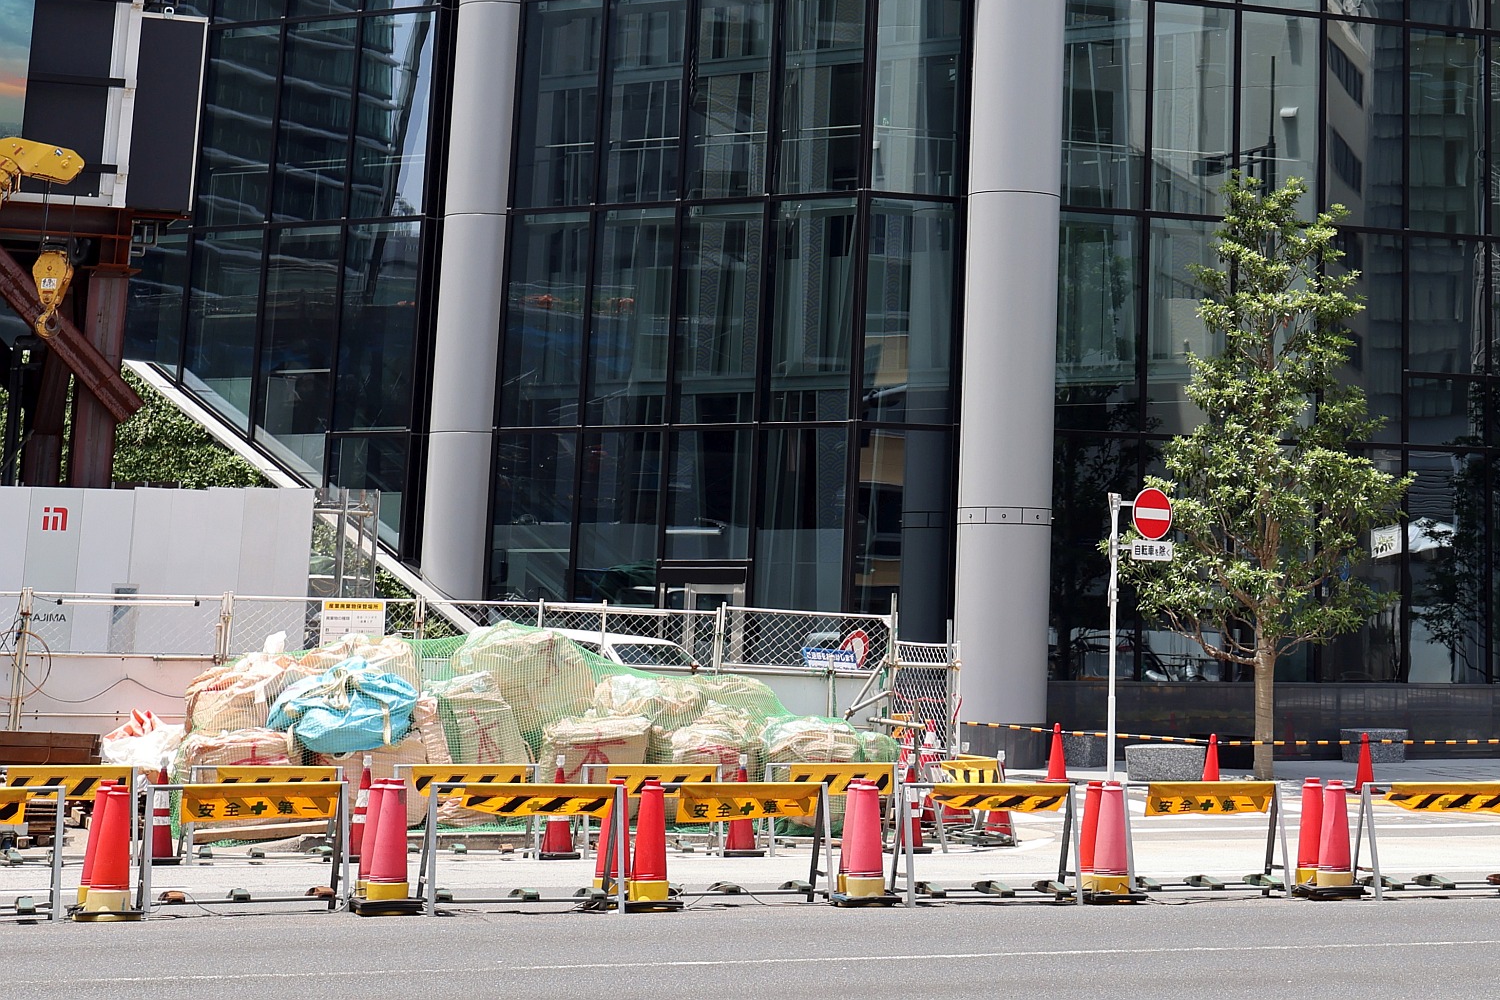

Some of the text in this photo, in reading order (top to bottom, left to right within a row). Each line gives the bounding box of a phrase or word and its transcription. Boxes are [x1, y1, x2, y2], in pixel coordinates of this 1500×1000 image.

[1134, 544, 1171, 557] 自転車を除く
[29, 613, 66, 622] AJIMA
[806, 651, 854, 662] ご迷惑をおけします
